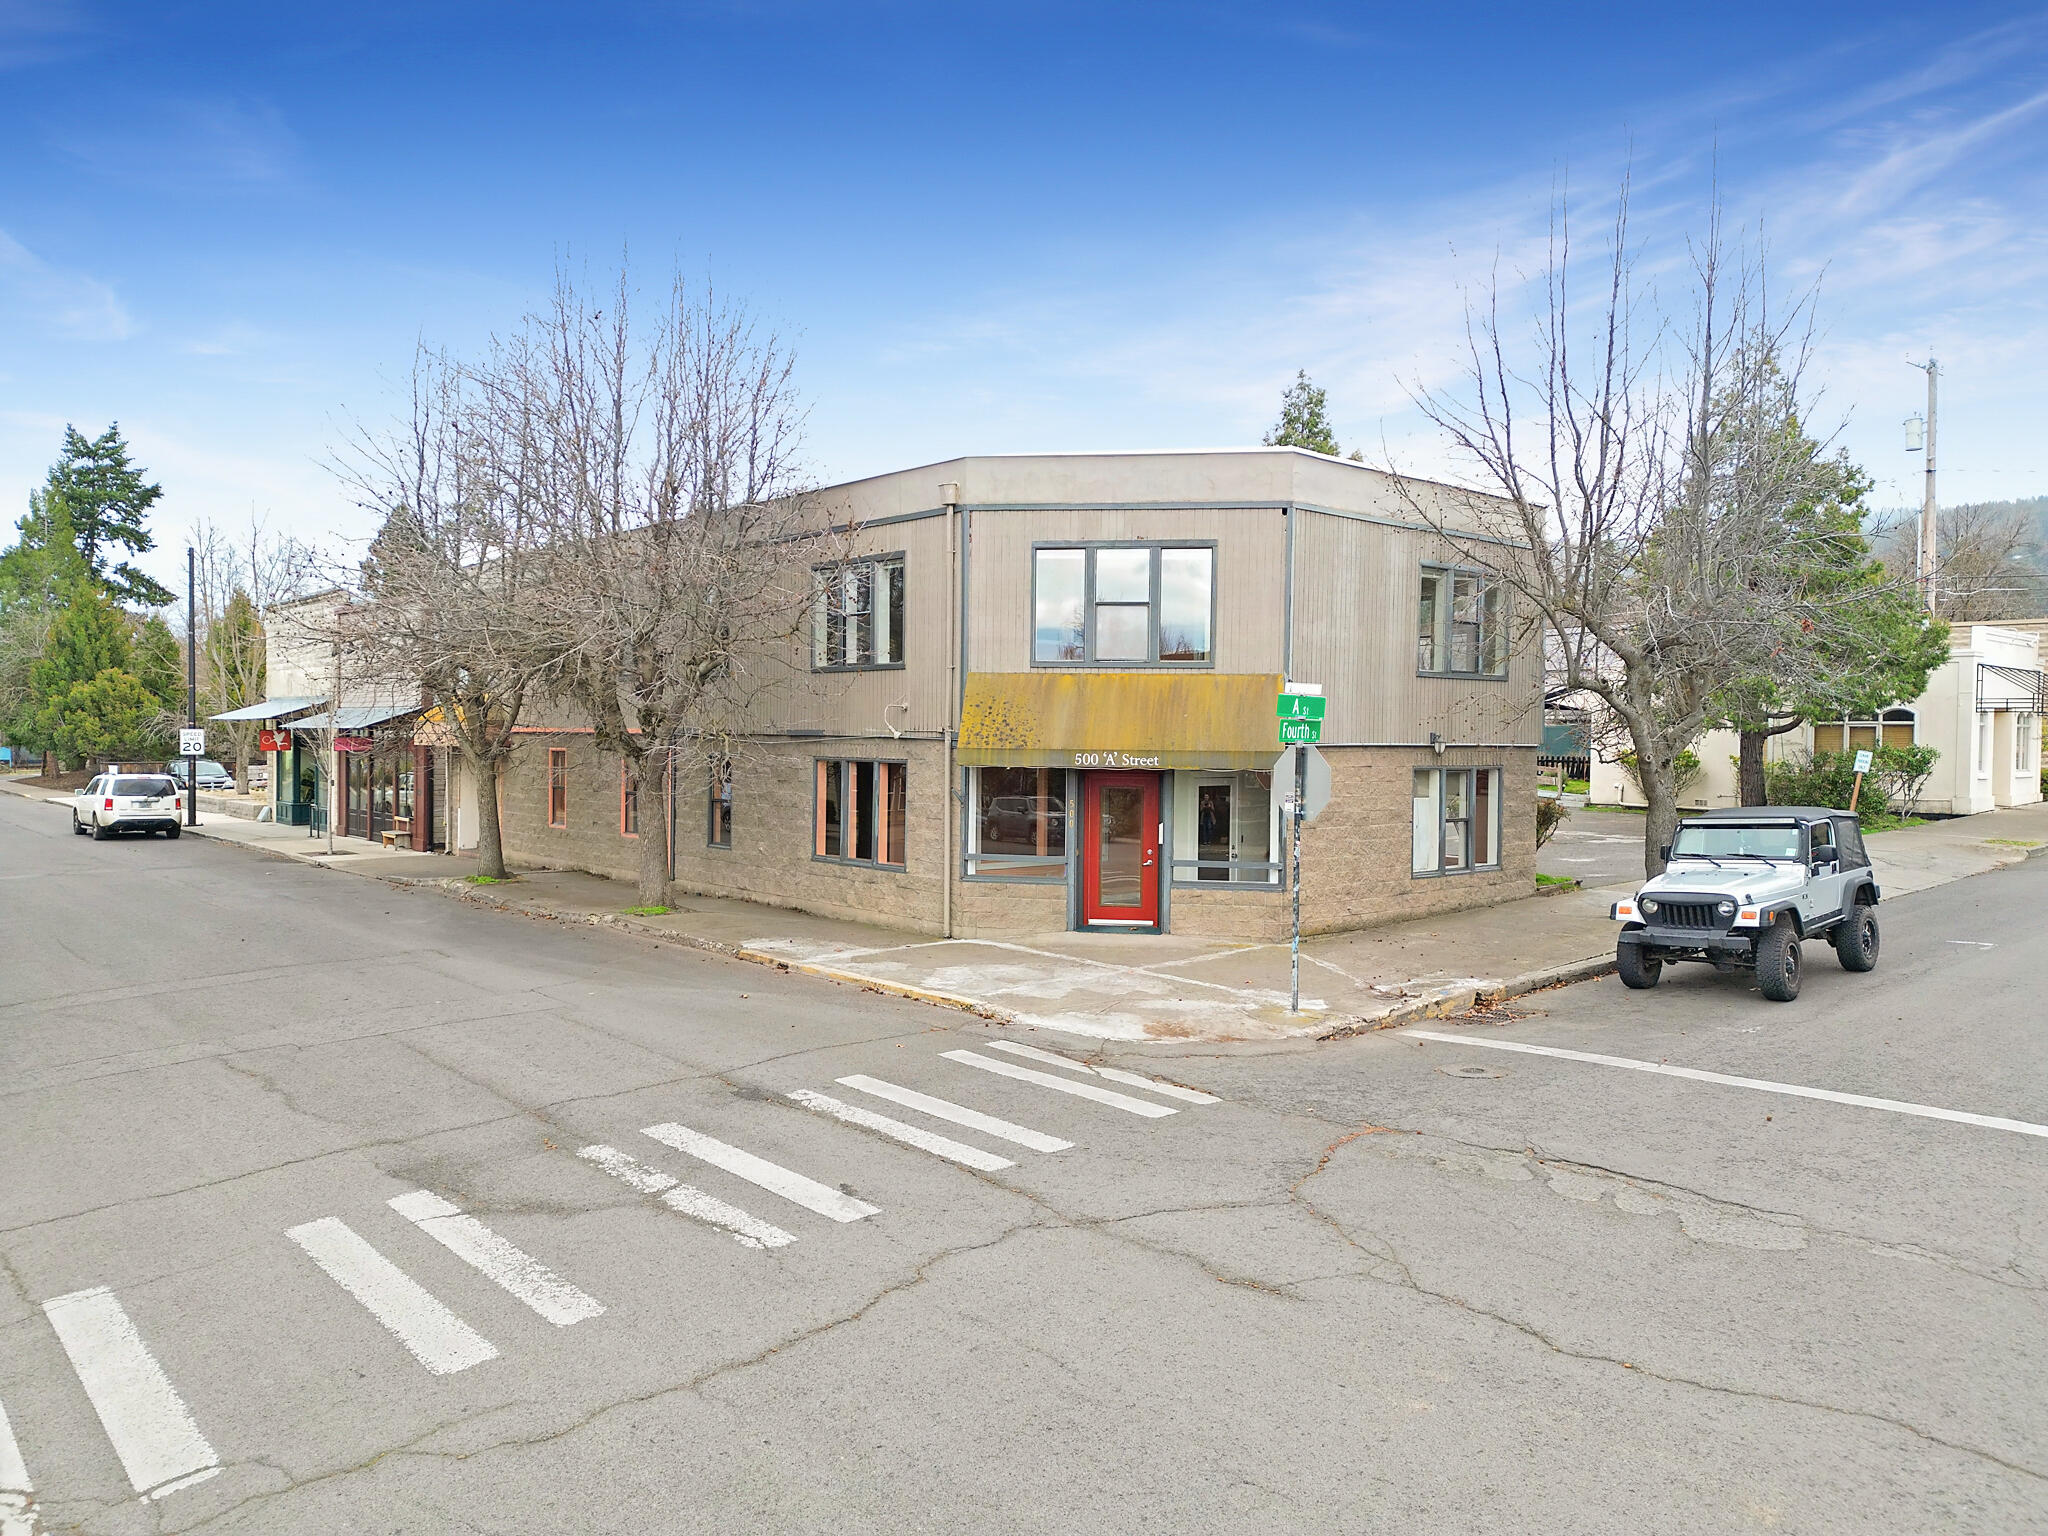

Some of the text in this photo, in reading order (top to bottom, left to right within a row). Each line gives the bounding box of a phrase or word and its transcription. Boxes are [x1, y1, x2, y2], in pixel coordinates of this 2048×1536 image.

[1291, 698, 1300, 715] A
[1282, 722, 1310, 739] Fourth
[182, 742, 201, 751] 20
[1074, 753, 1099, 766] 500
[1121, 753, 1160, 766] Street
